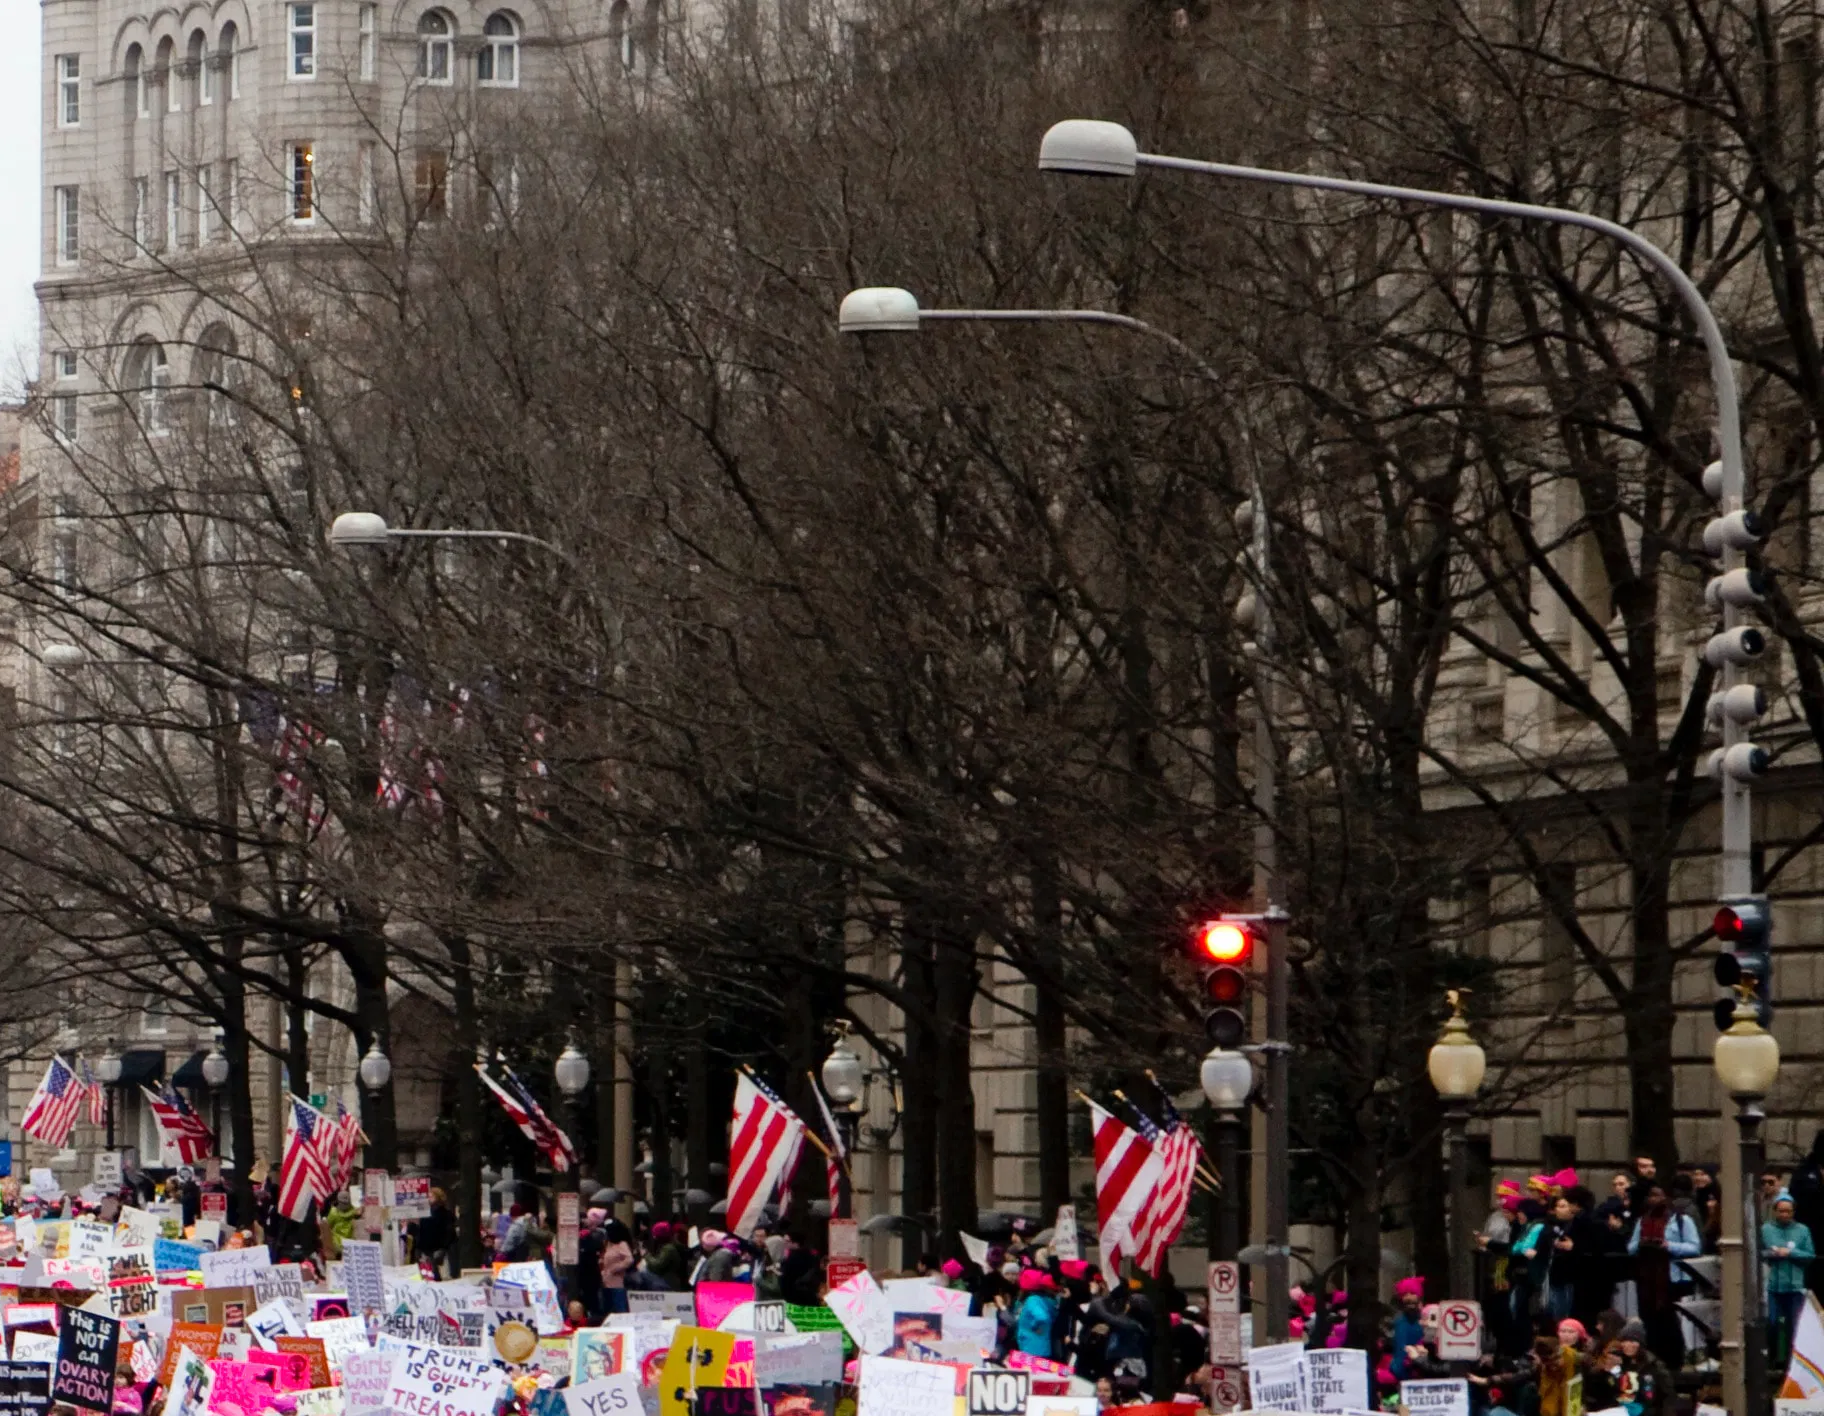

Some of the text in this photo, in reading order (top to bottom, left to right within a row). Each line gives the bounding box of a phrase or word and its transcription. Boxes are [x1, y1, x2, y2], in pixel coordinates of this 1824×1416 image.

[405, 1344, 491, 1375] TRUMP
[406, 1364, 493, 1391] IS GUILTY
[433, 1383, 457, 1395] OF
